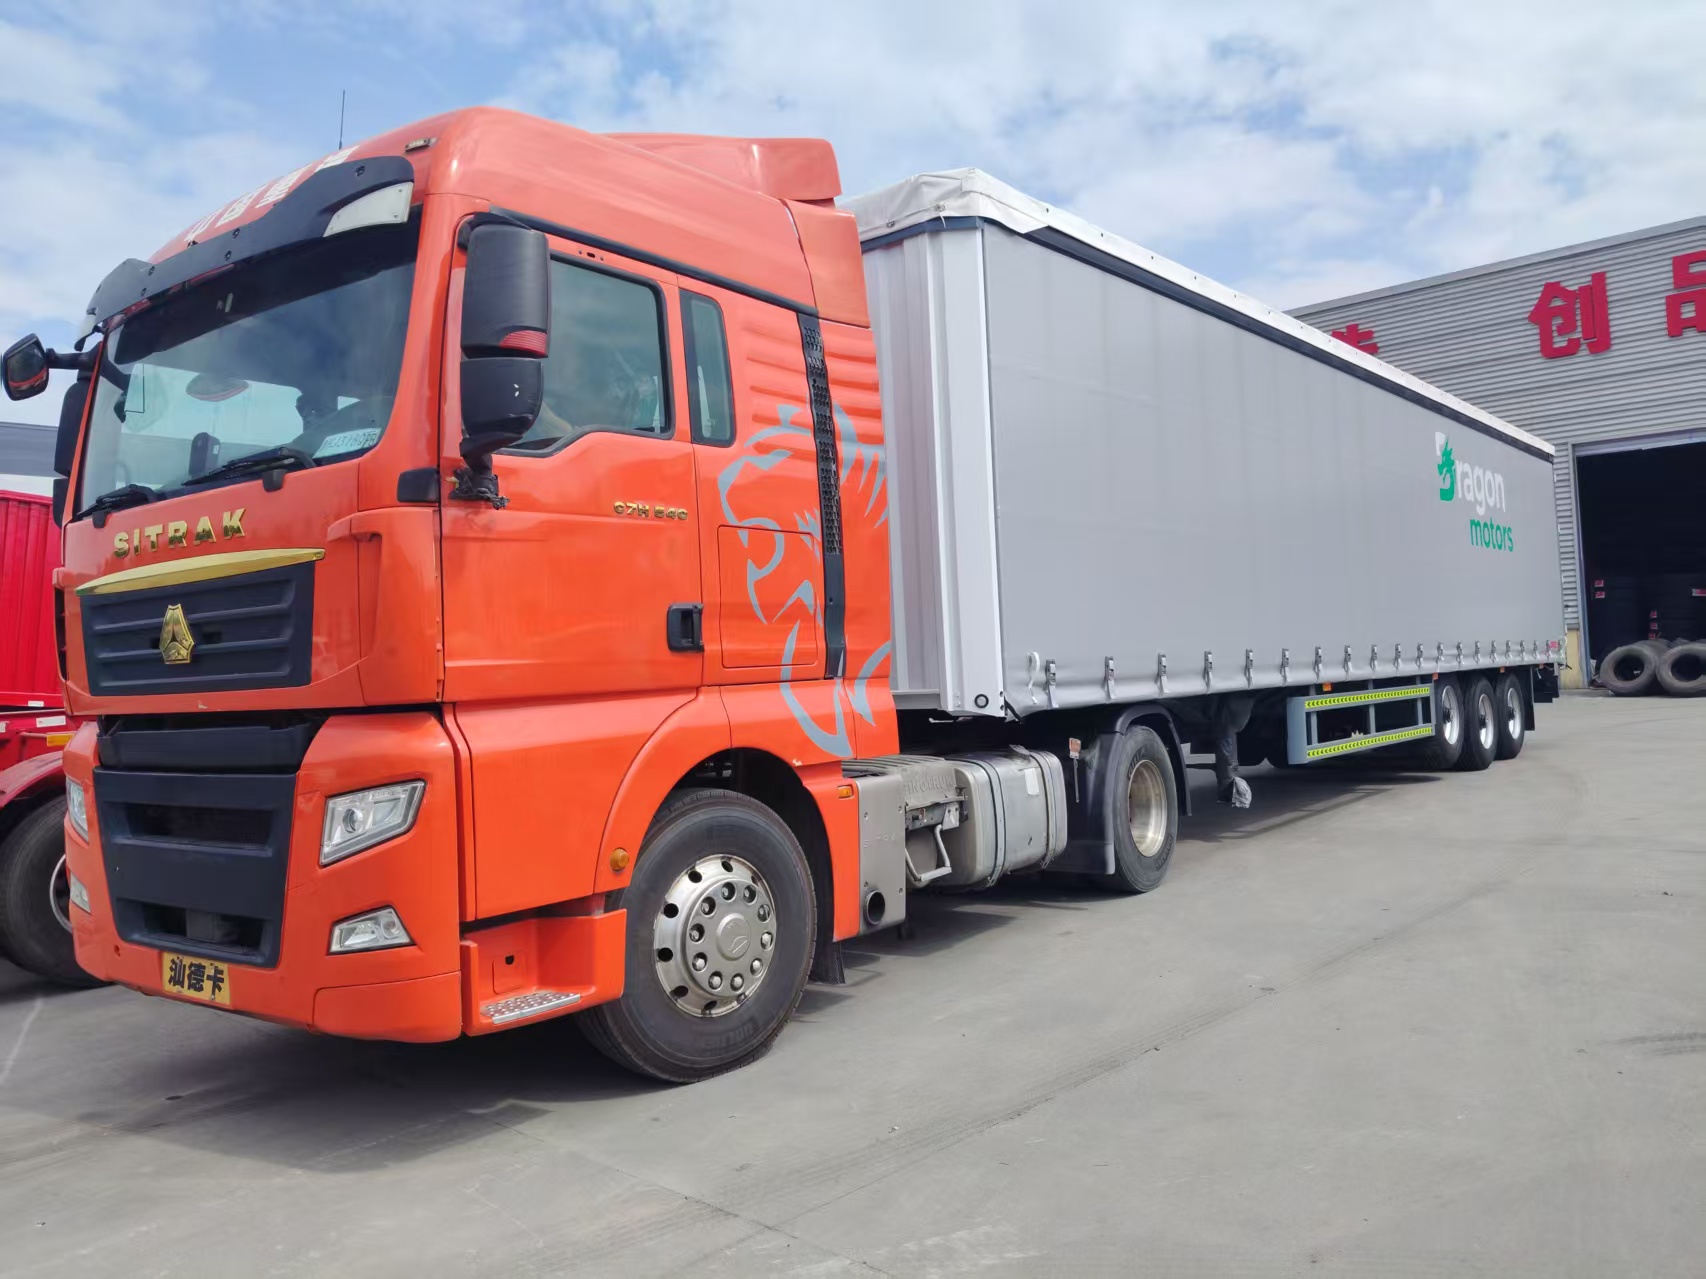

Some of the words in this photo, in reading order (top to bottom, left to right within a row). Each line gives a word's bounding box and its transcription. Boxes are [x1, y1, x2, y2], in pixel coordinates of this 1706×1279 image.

[114, 508, 246, 558] SITRAK
[1469, 517, 1514, 552] motors
[168, 957, 225, 1000] 汕德卡
